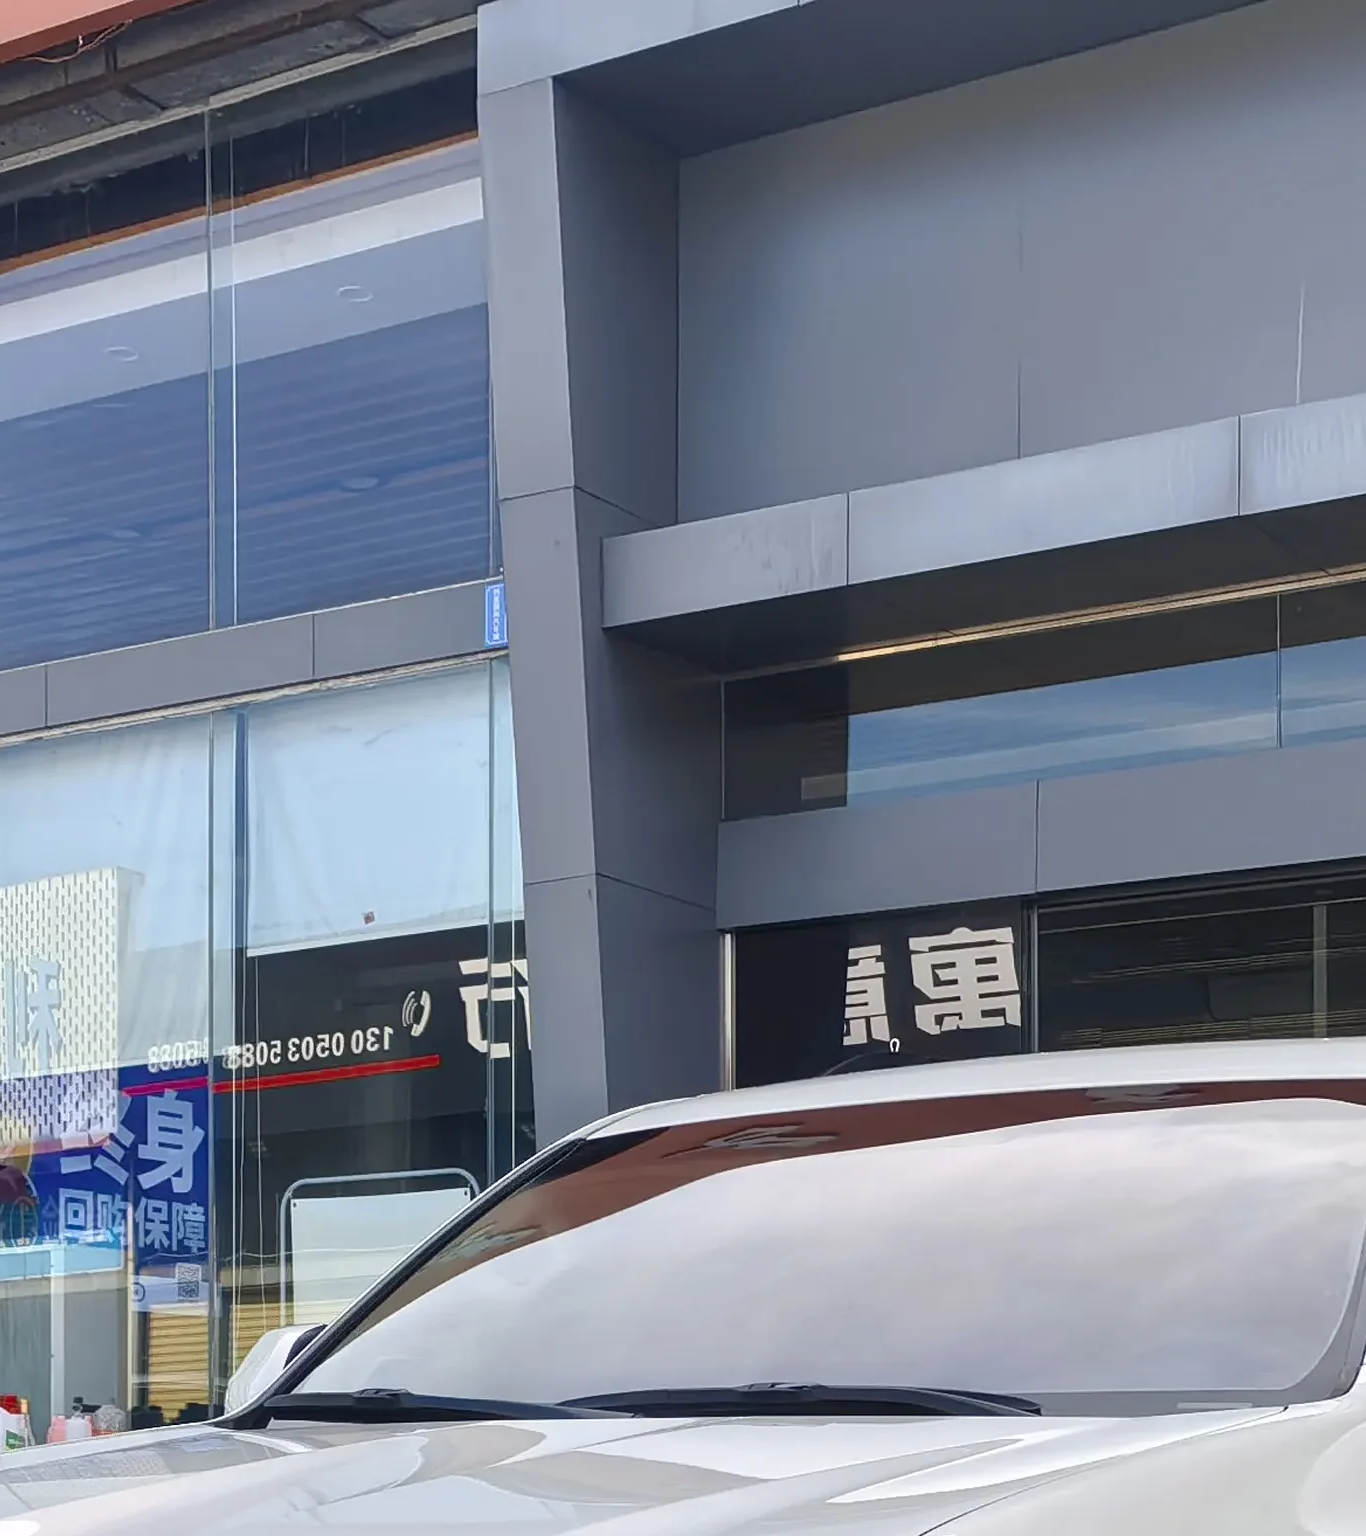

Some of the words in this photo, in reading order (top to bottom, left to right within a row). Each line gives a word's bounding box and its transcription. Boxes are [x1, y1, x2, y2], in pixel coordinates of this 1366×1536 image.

[60, 1089, 206, 1194] 终身
[59, 1188, 207, 1254] 回购保障
